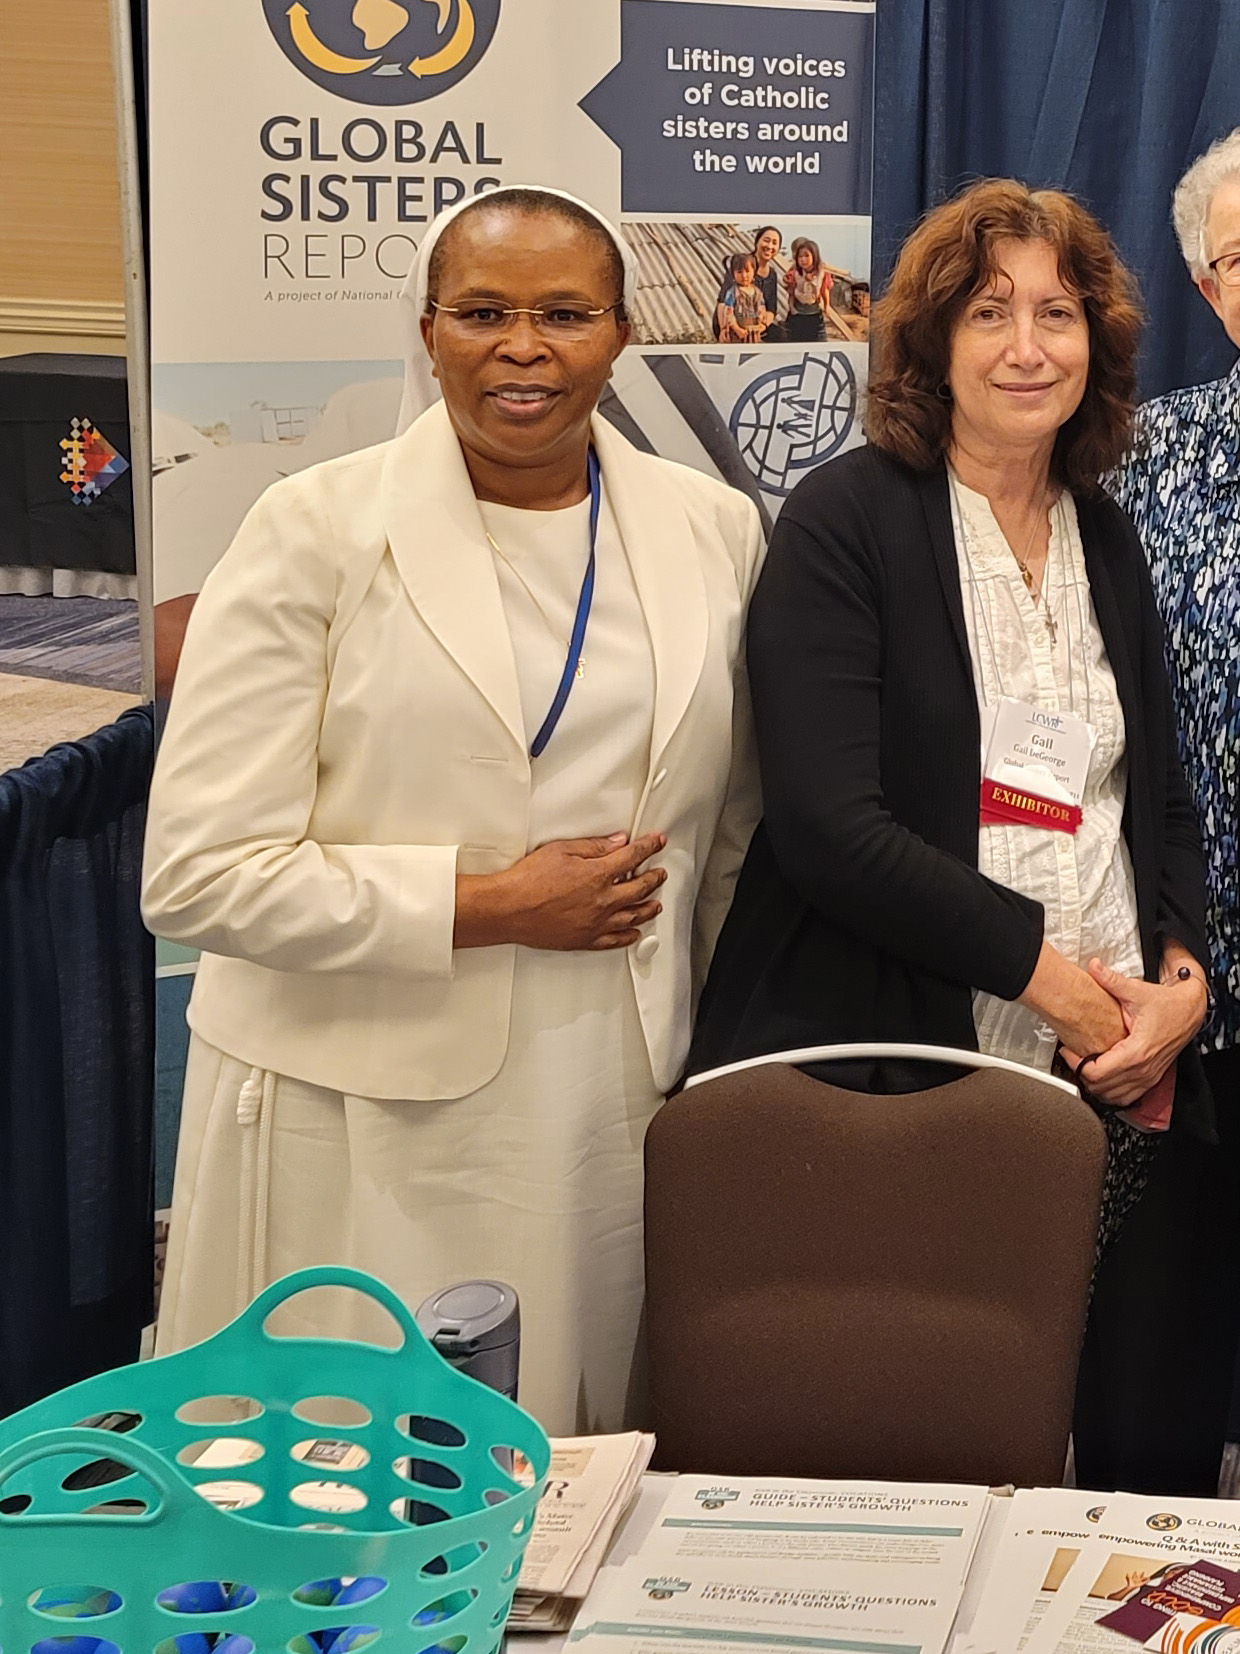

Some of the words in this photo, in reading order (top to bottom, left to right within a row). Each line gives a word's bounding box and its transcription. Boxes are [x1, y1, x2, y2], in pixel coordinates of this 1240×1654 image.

[667, 47, 755, 78] Lifting
[763, 54, 847, 78] voices
[684, 82, 713, 105] of
[721, 84, 830, 109] Catholic
[662, 115, 750, 140] sisters
[757, 120, 848, 142] around
[260, 115, 503, 165] GLOBAL
[693, 149, 737, 172] the
[745, 152, 820, 174] world
[264, 234, 419, 279] REPO
[264, 291, 273, 300] A
[278, 291, 321, 302] project
[325, 290, 339, 300] of
[341, 290, 392, 300] National
[1013, 743, 1028, 755] Gail
[1031, 734, 1053, 750] Gail
[992, 787, 1070, 821] EXHIBITOR
[753, 1493, 797, 1501] GUIDE
[890, 1497, 969, 1507] QUESTIONS
[849, 1503, 911, 1512] GROWTH
[1098, 1533, 1177, 1551] empowering
[1203, 1540, 1230, 1549] with
[803, 1600, 869, 1611] GROWTH
[855, 1596, 937, 1607] QUESTIONS
